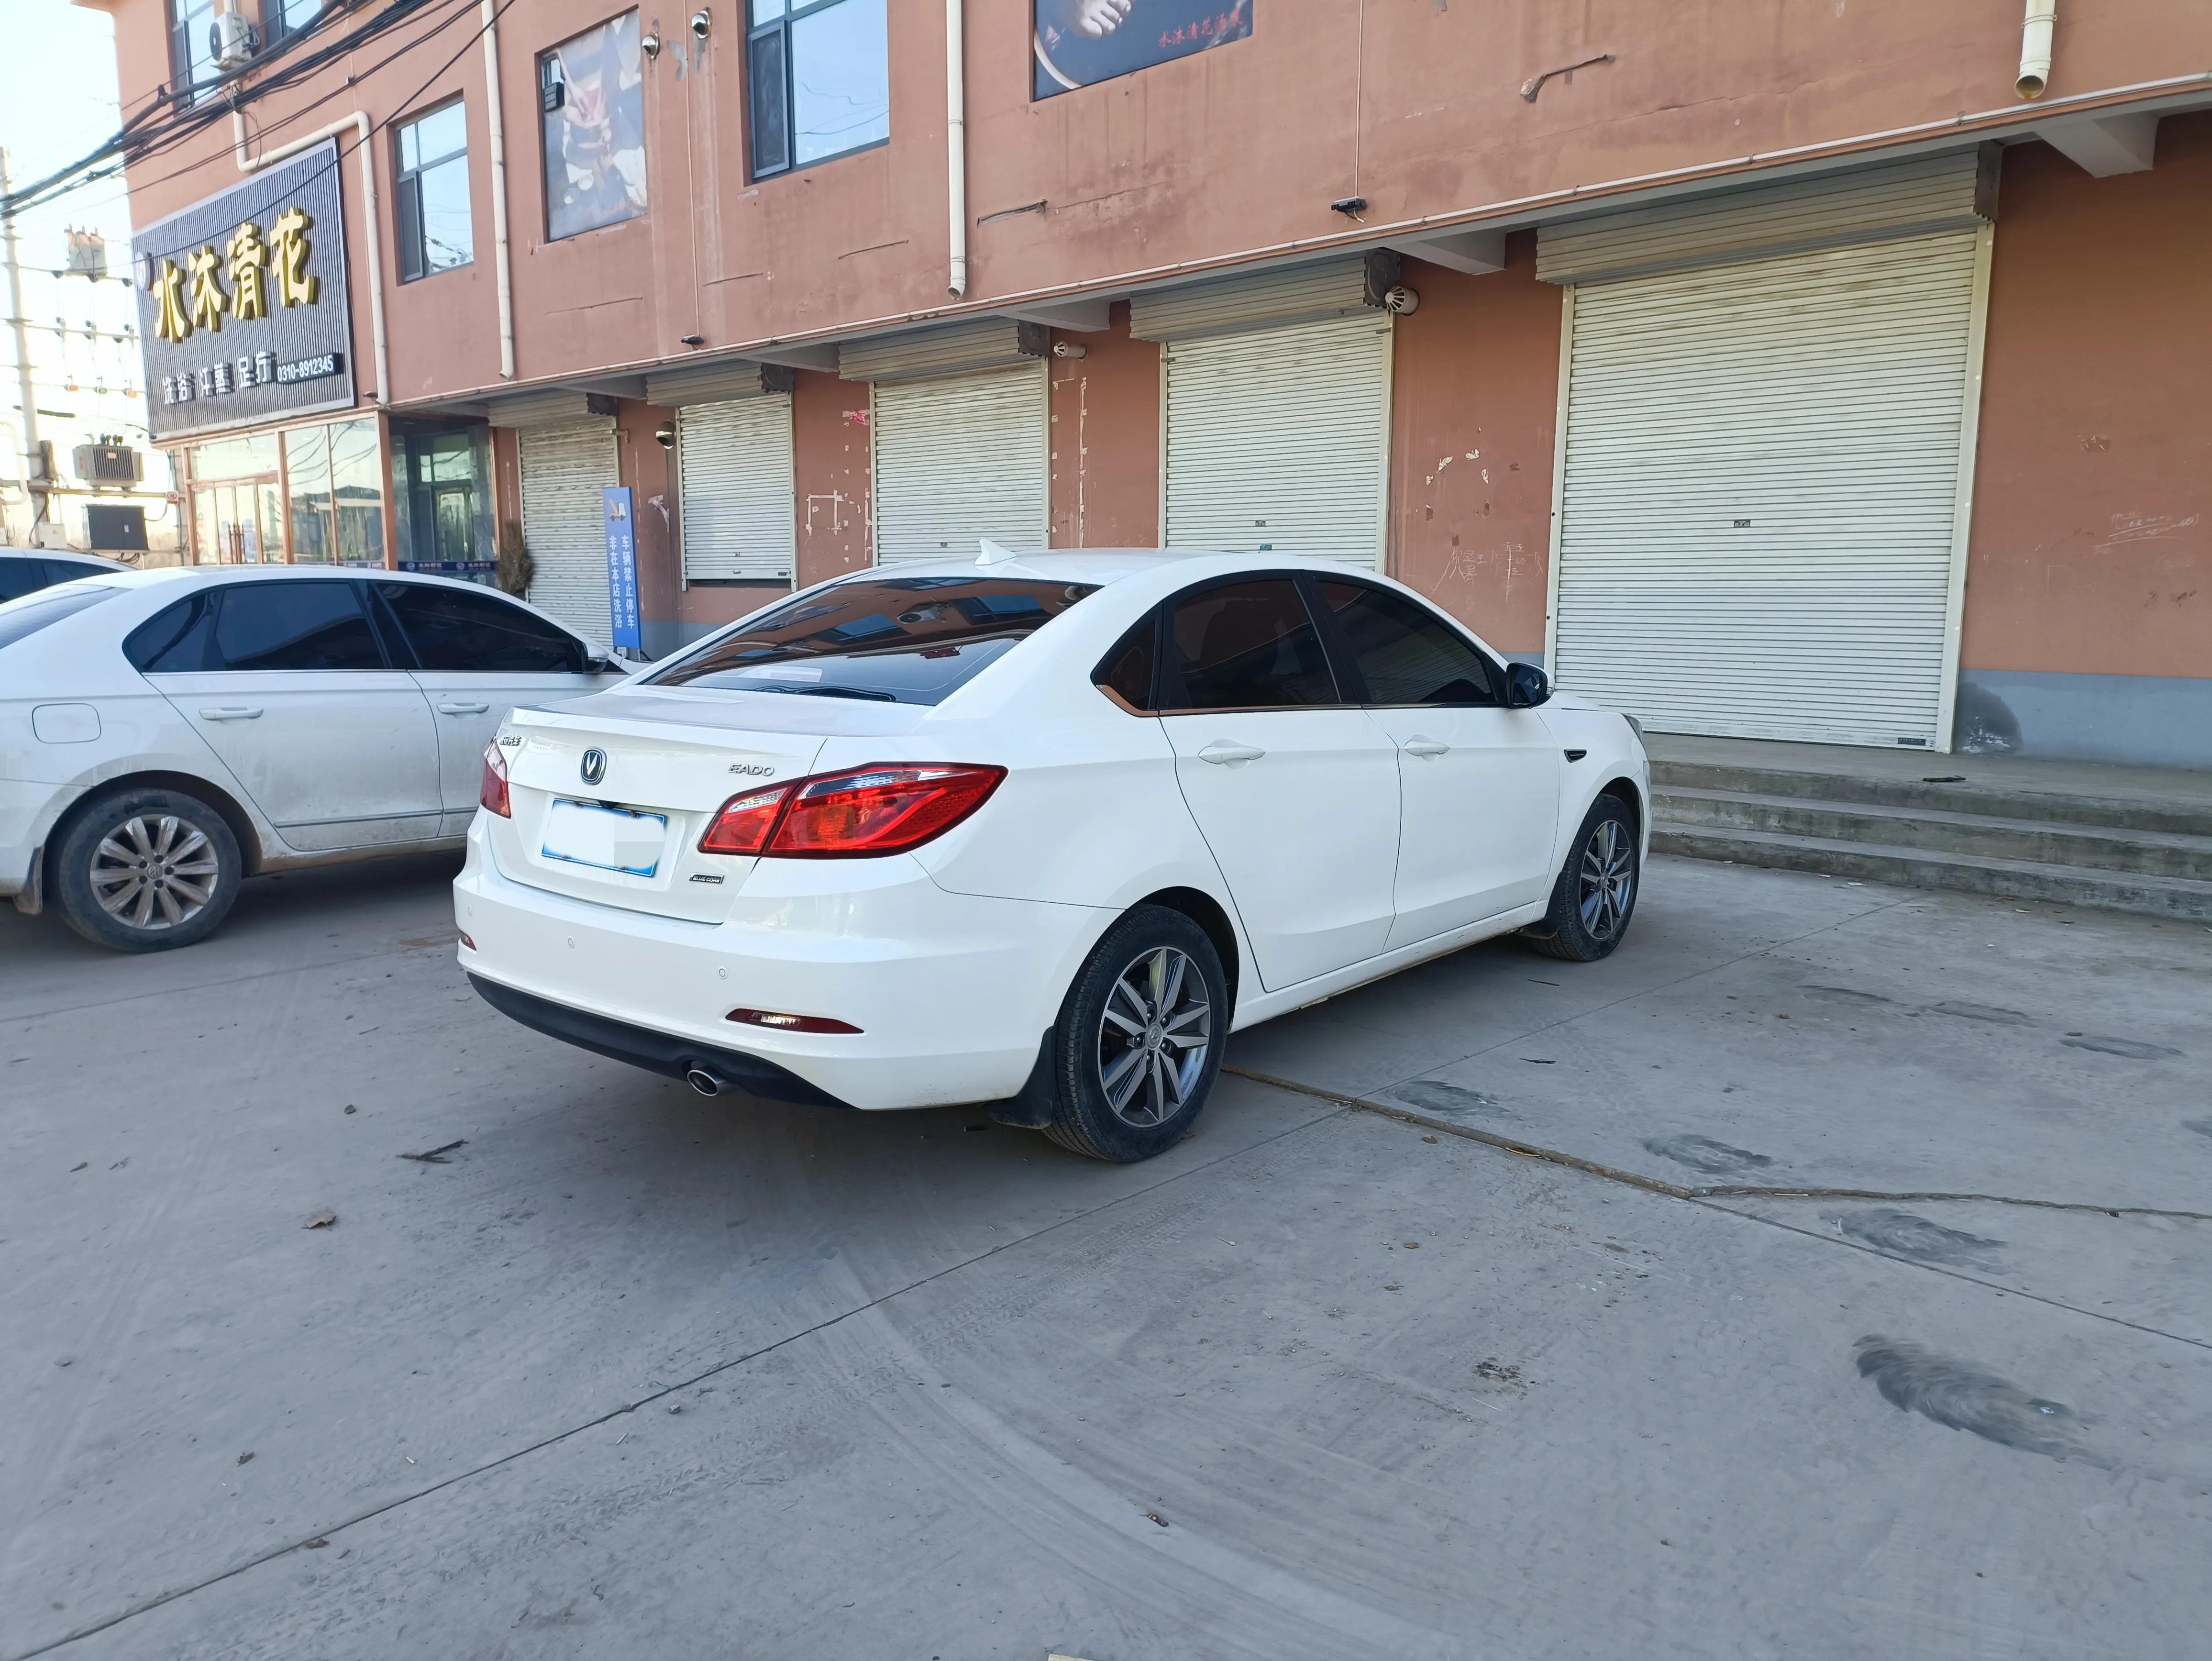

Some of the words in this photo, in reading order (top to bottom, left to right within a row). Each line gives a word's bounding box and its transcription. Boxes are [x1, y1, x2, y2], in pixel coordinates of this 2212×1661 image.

[238, 351, 271, 389] 足疗
[277, 354, 333, 383] 0310-8912345
[609, 535, 622, 628] 非在本店洗浴
[621, 534, 635, 629] 车辆禁止停车
[728, 763, 774, 776] EADO
